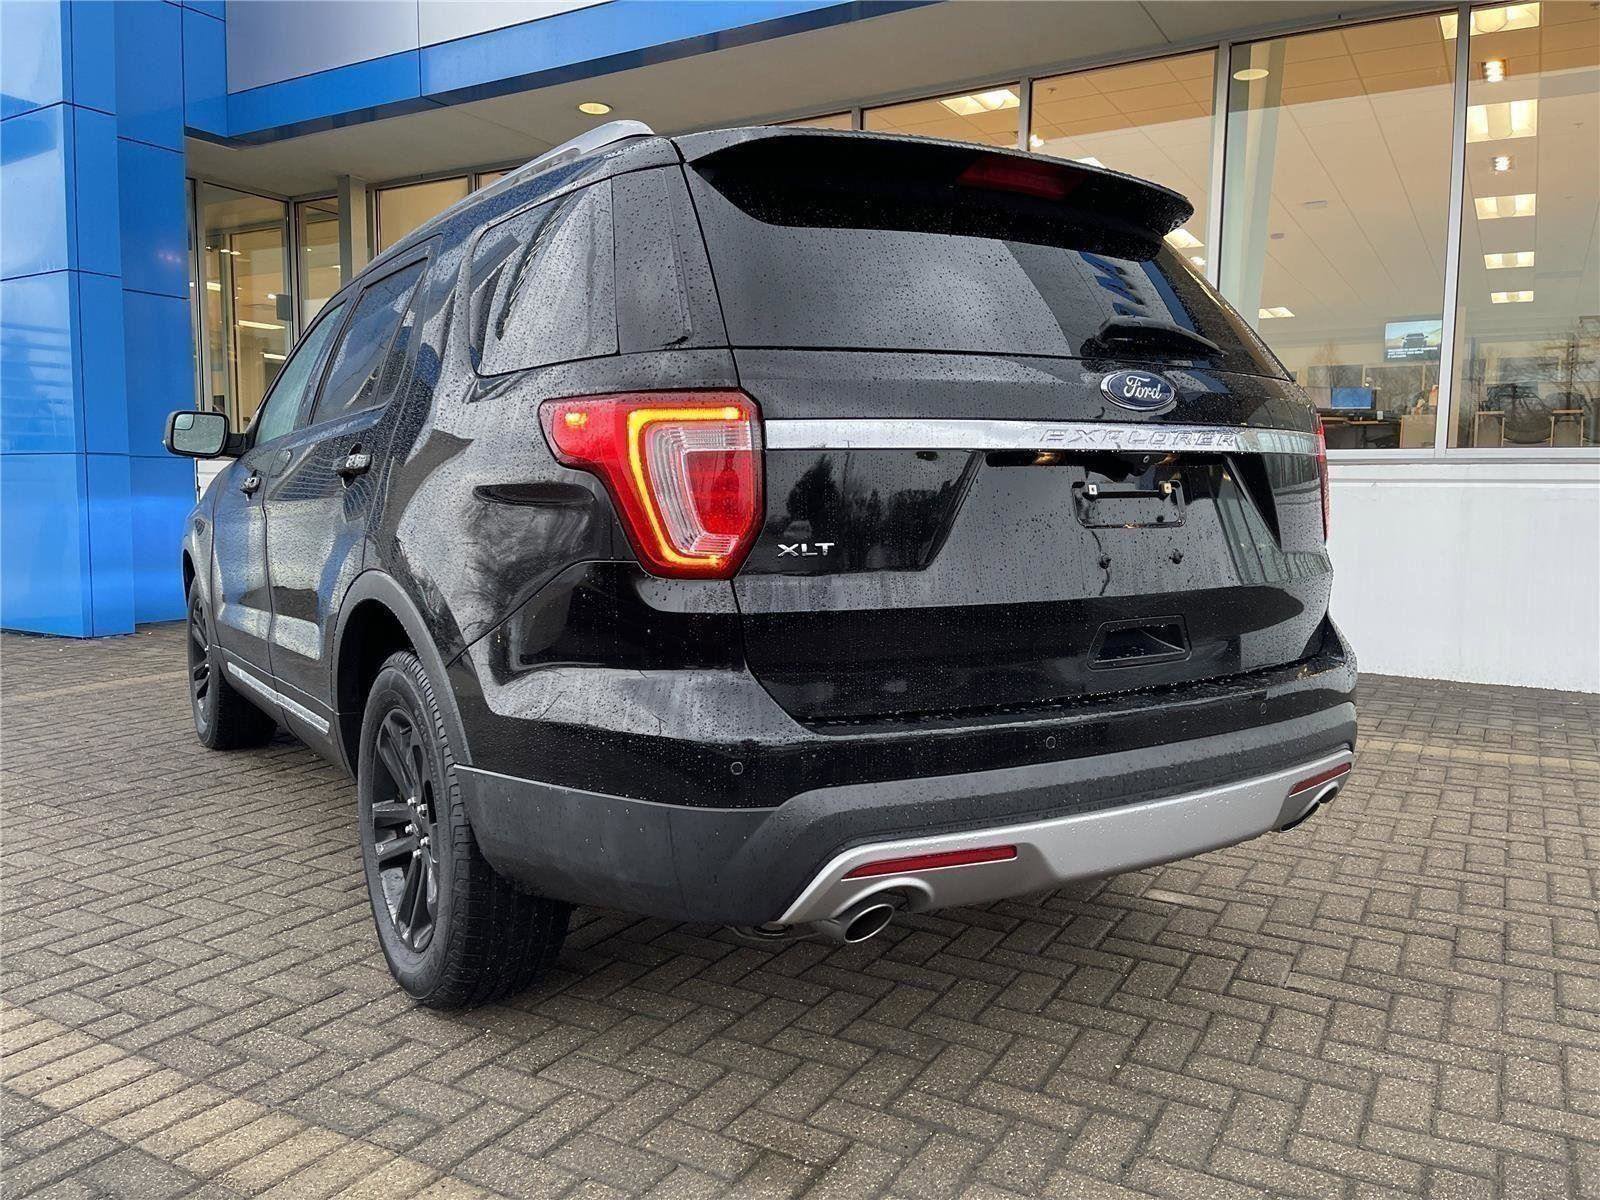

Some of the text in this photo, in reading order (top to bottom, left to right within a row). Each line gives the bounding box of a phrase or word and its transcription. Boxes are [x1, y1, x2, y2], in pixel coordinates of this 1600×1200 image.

[1122, 375, 1163, 400] Ford
[1039, 428, 1237, 448] EXPLORER
[777, 542, 835, 557] XLT
